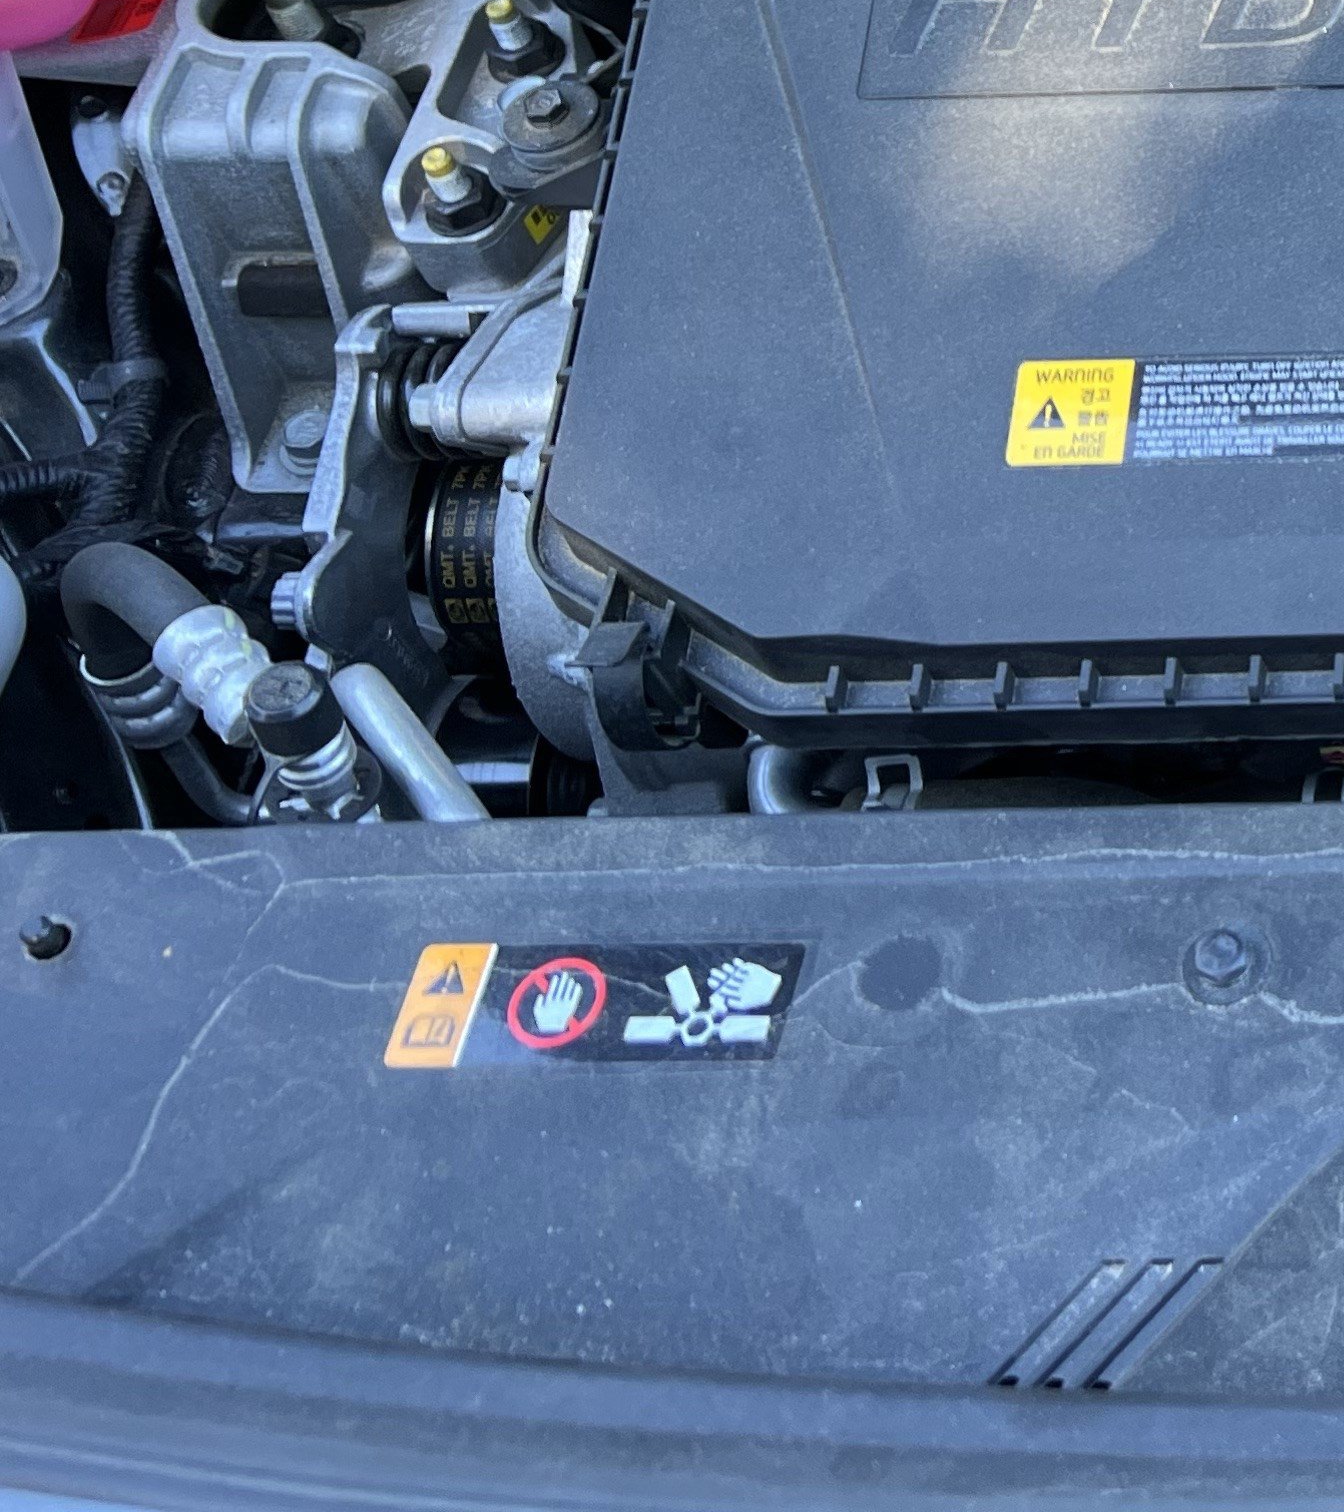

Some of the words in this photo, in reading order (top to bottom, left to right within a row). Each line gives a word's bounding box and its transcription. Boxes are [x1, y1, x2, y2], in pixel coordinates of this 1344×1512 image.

[1036, 366, 1115, 385] WARNING
[1072, 431, 1107, 445] MISE
[1033, 445, 1053, 459] EN
[1057, 443, 1104, 459] GARDE
[442, 497, 460, 538] BELT
[463, 497, 481, 538] BELT
